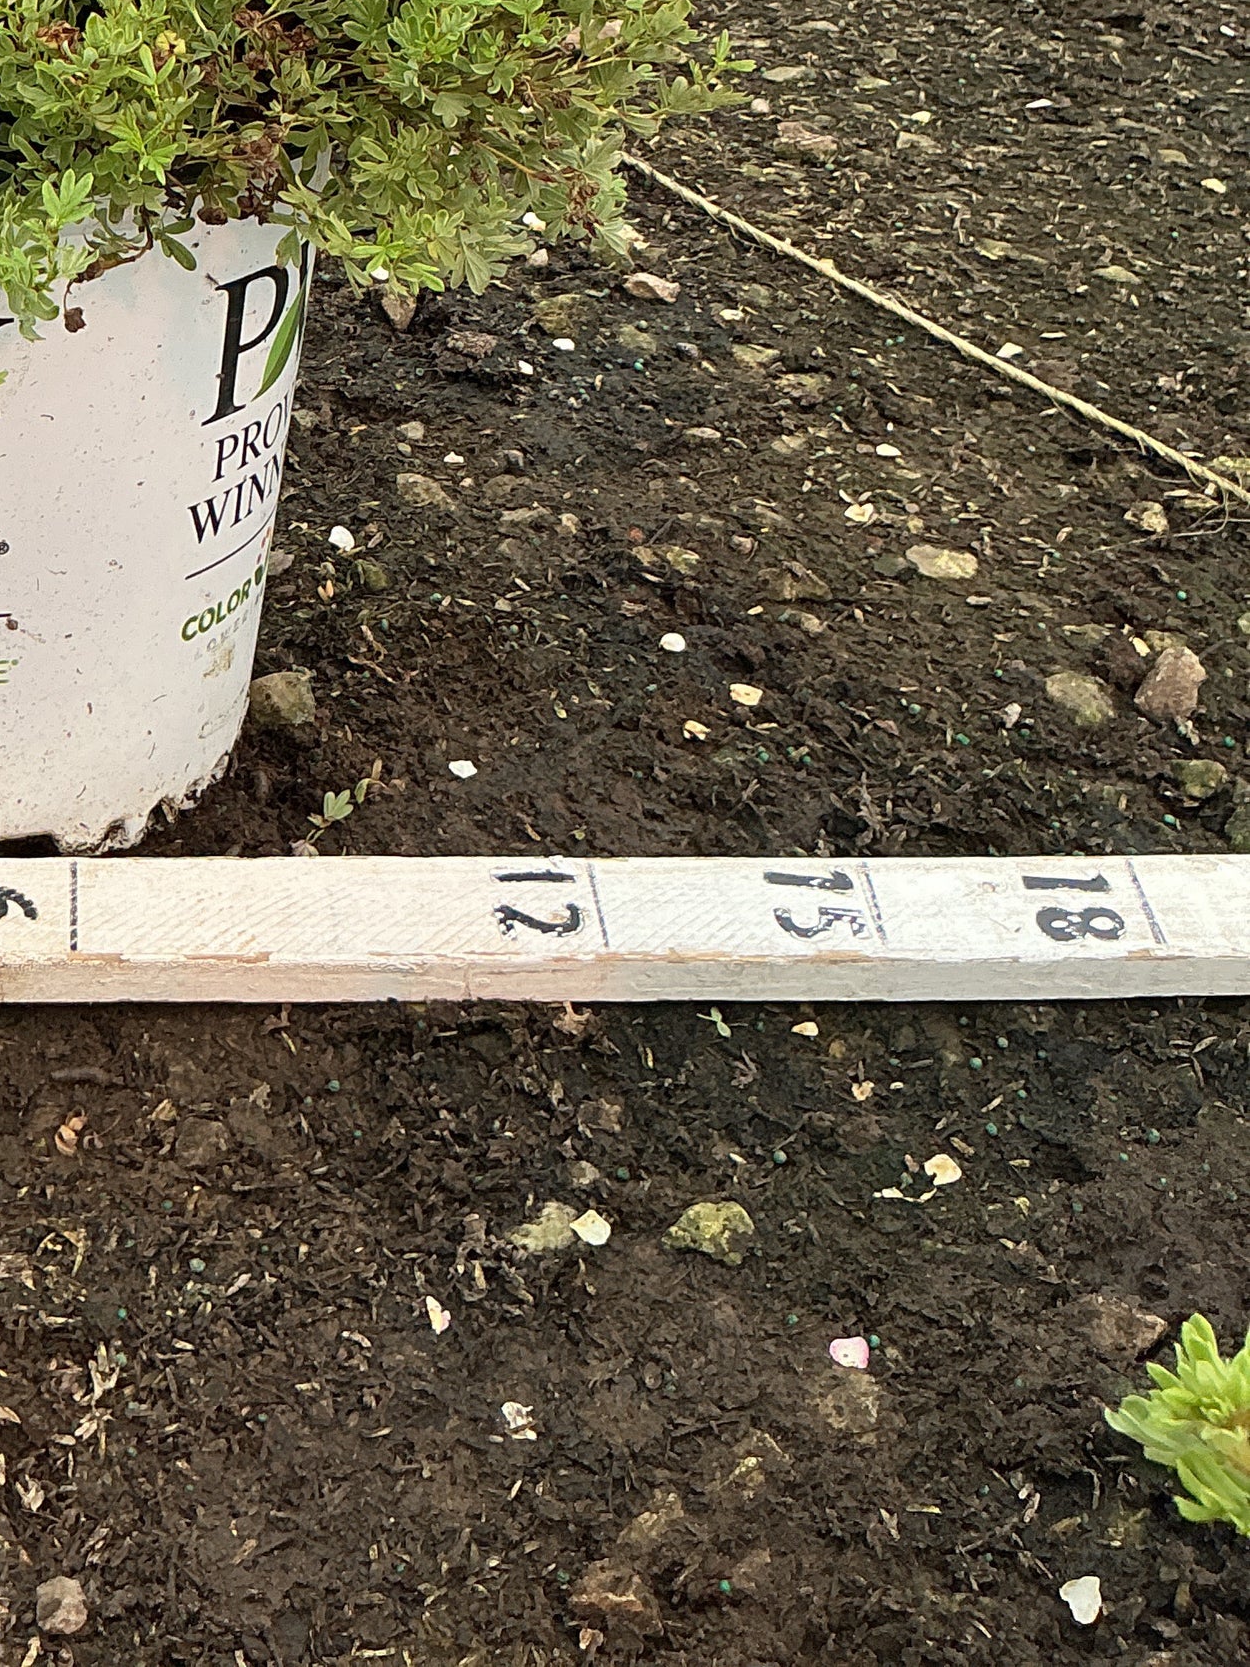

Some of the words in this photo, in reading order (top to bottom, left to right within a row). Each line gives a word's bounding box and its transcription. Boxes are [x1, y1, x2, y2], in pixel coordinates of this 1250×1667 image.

[181, 577, 251, 642] COLOR
[490, 867, 586, 939] 12
[763, 869, 866, 938] 15
[1022, 872, 1126, 941] 18
